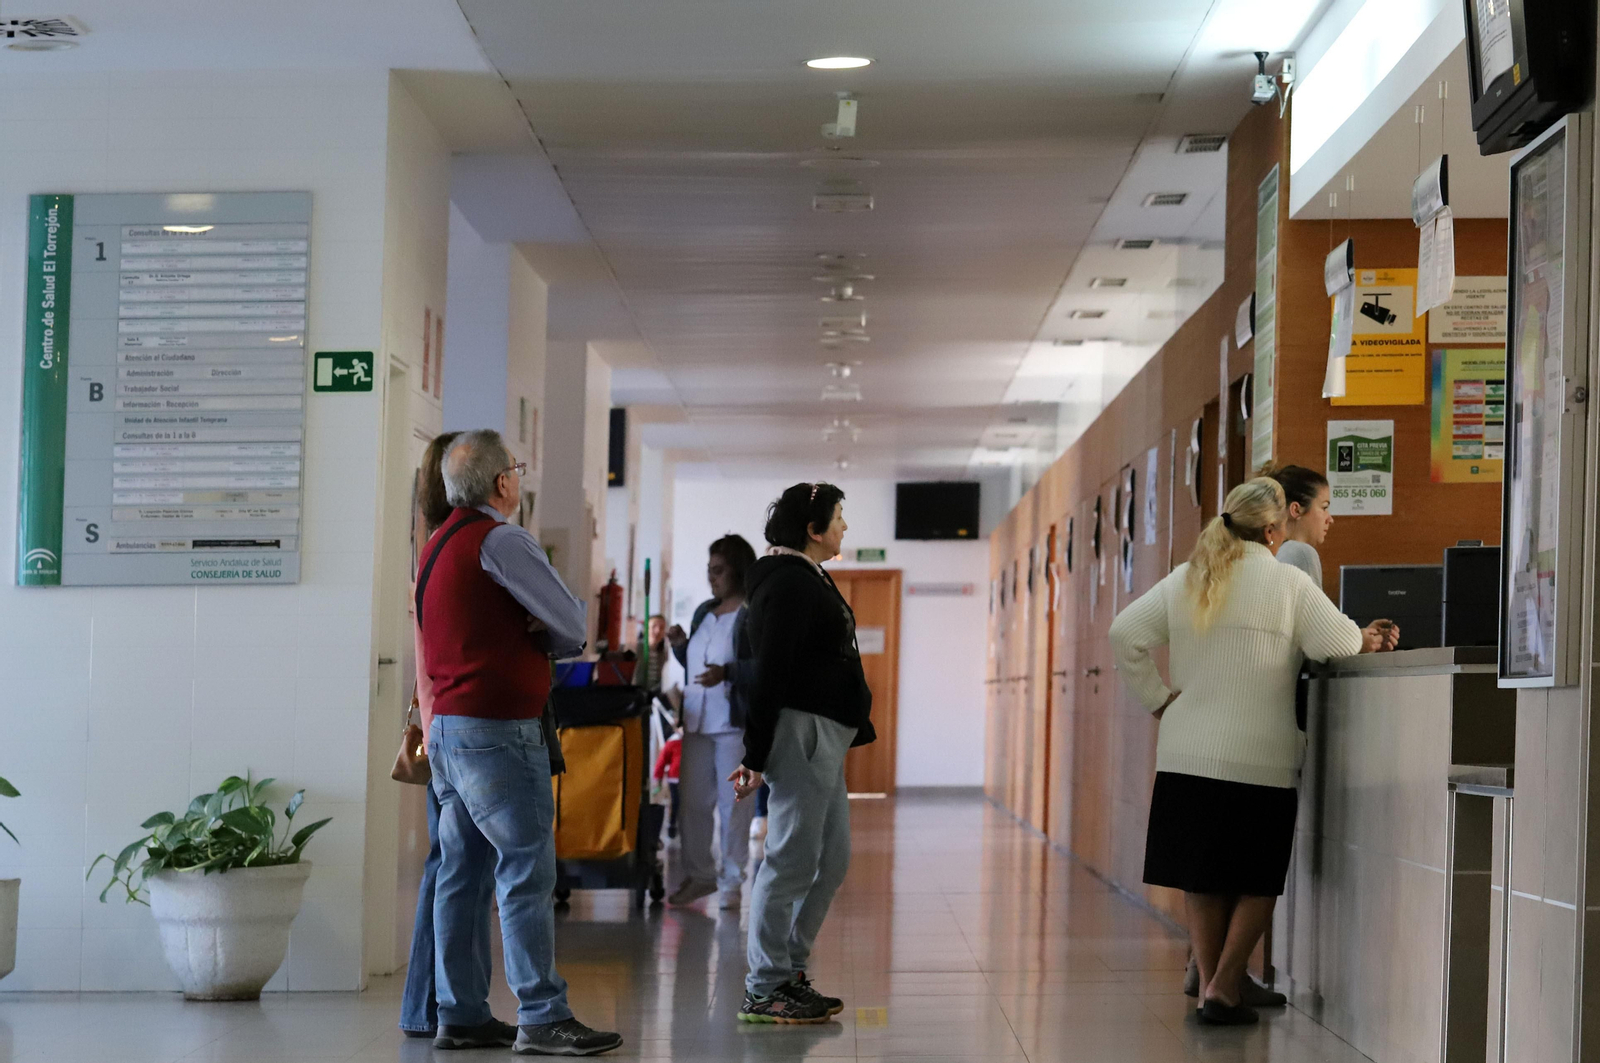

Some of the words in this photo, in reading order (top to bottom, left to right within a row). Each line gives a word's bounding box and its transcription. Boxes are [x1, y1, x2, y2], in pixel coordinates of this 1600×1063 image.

[43, 208, 60, 258] Torrejón
[129, 229, 160, 237] Consultas
[96, 242, 107, 261] 1
[42, 261, 56, 272] El
[42, 275, 56, 308] Salud
[42, 311, 55, 326] de
[40, 328, 54, 369] Centro
[90, 382, 104, 402] B
[124, 385, 158, 393] Trabajador
[166, 401, 199, 409] Recepción
[1333, 489, 1349, 498] 955
[1351, 489, 1368, 498] 545
[1370, 489, 1387, 498] 060
[85, 523, 99, 544] S
[190, 558, 219, 567] Servicio
[219, 558, 250, 567] Andaluz
[251, 558, 261, 567] de
[262, 558, 282, 567] Salud
[242, 570, 252, 579] DE
[255, 570, 282, 578] SALUD
